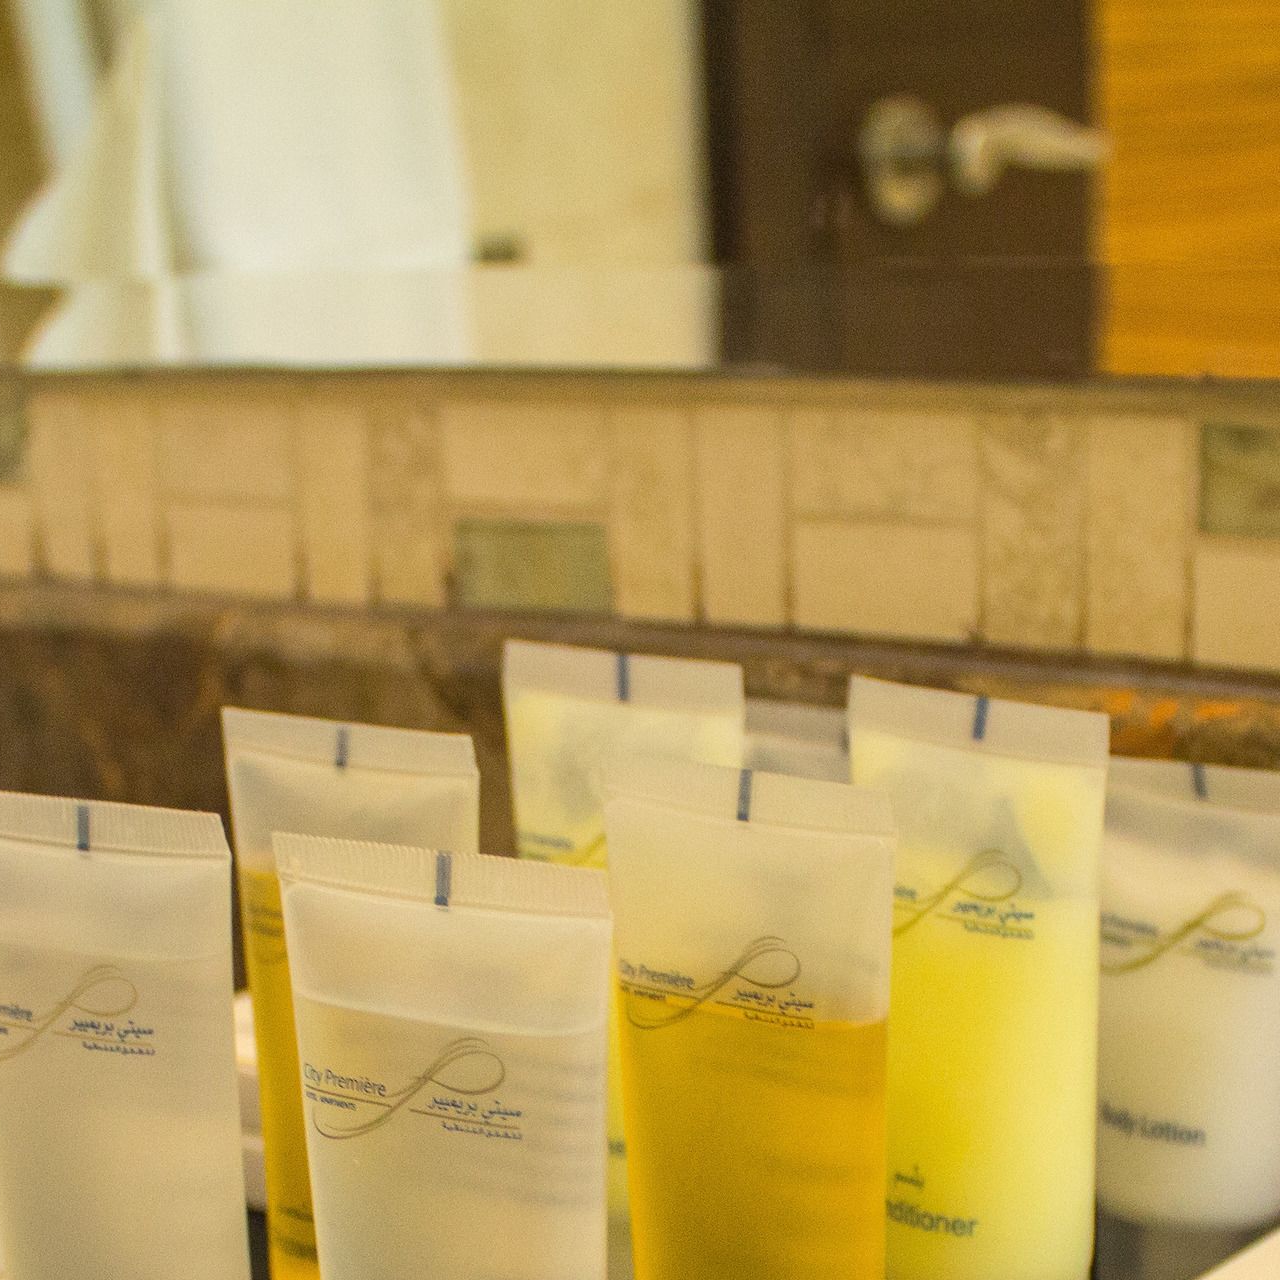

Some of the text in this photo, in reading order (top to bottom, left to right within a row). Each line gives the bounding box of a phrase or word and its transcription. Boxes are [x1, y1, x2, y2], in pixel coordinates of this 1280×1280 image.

[304, 1063, 322, 1084] City
[324, 1069, 387, 1097] Première
[885, 1200, 979, 1237] nditioner
